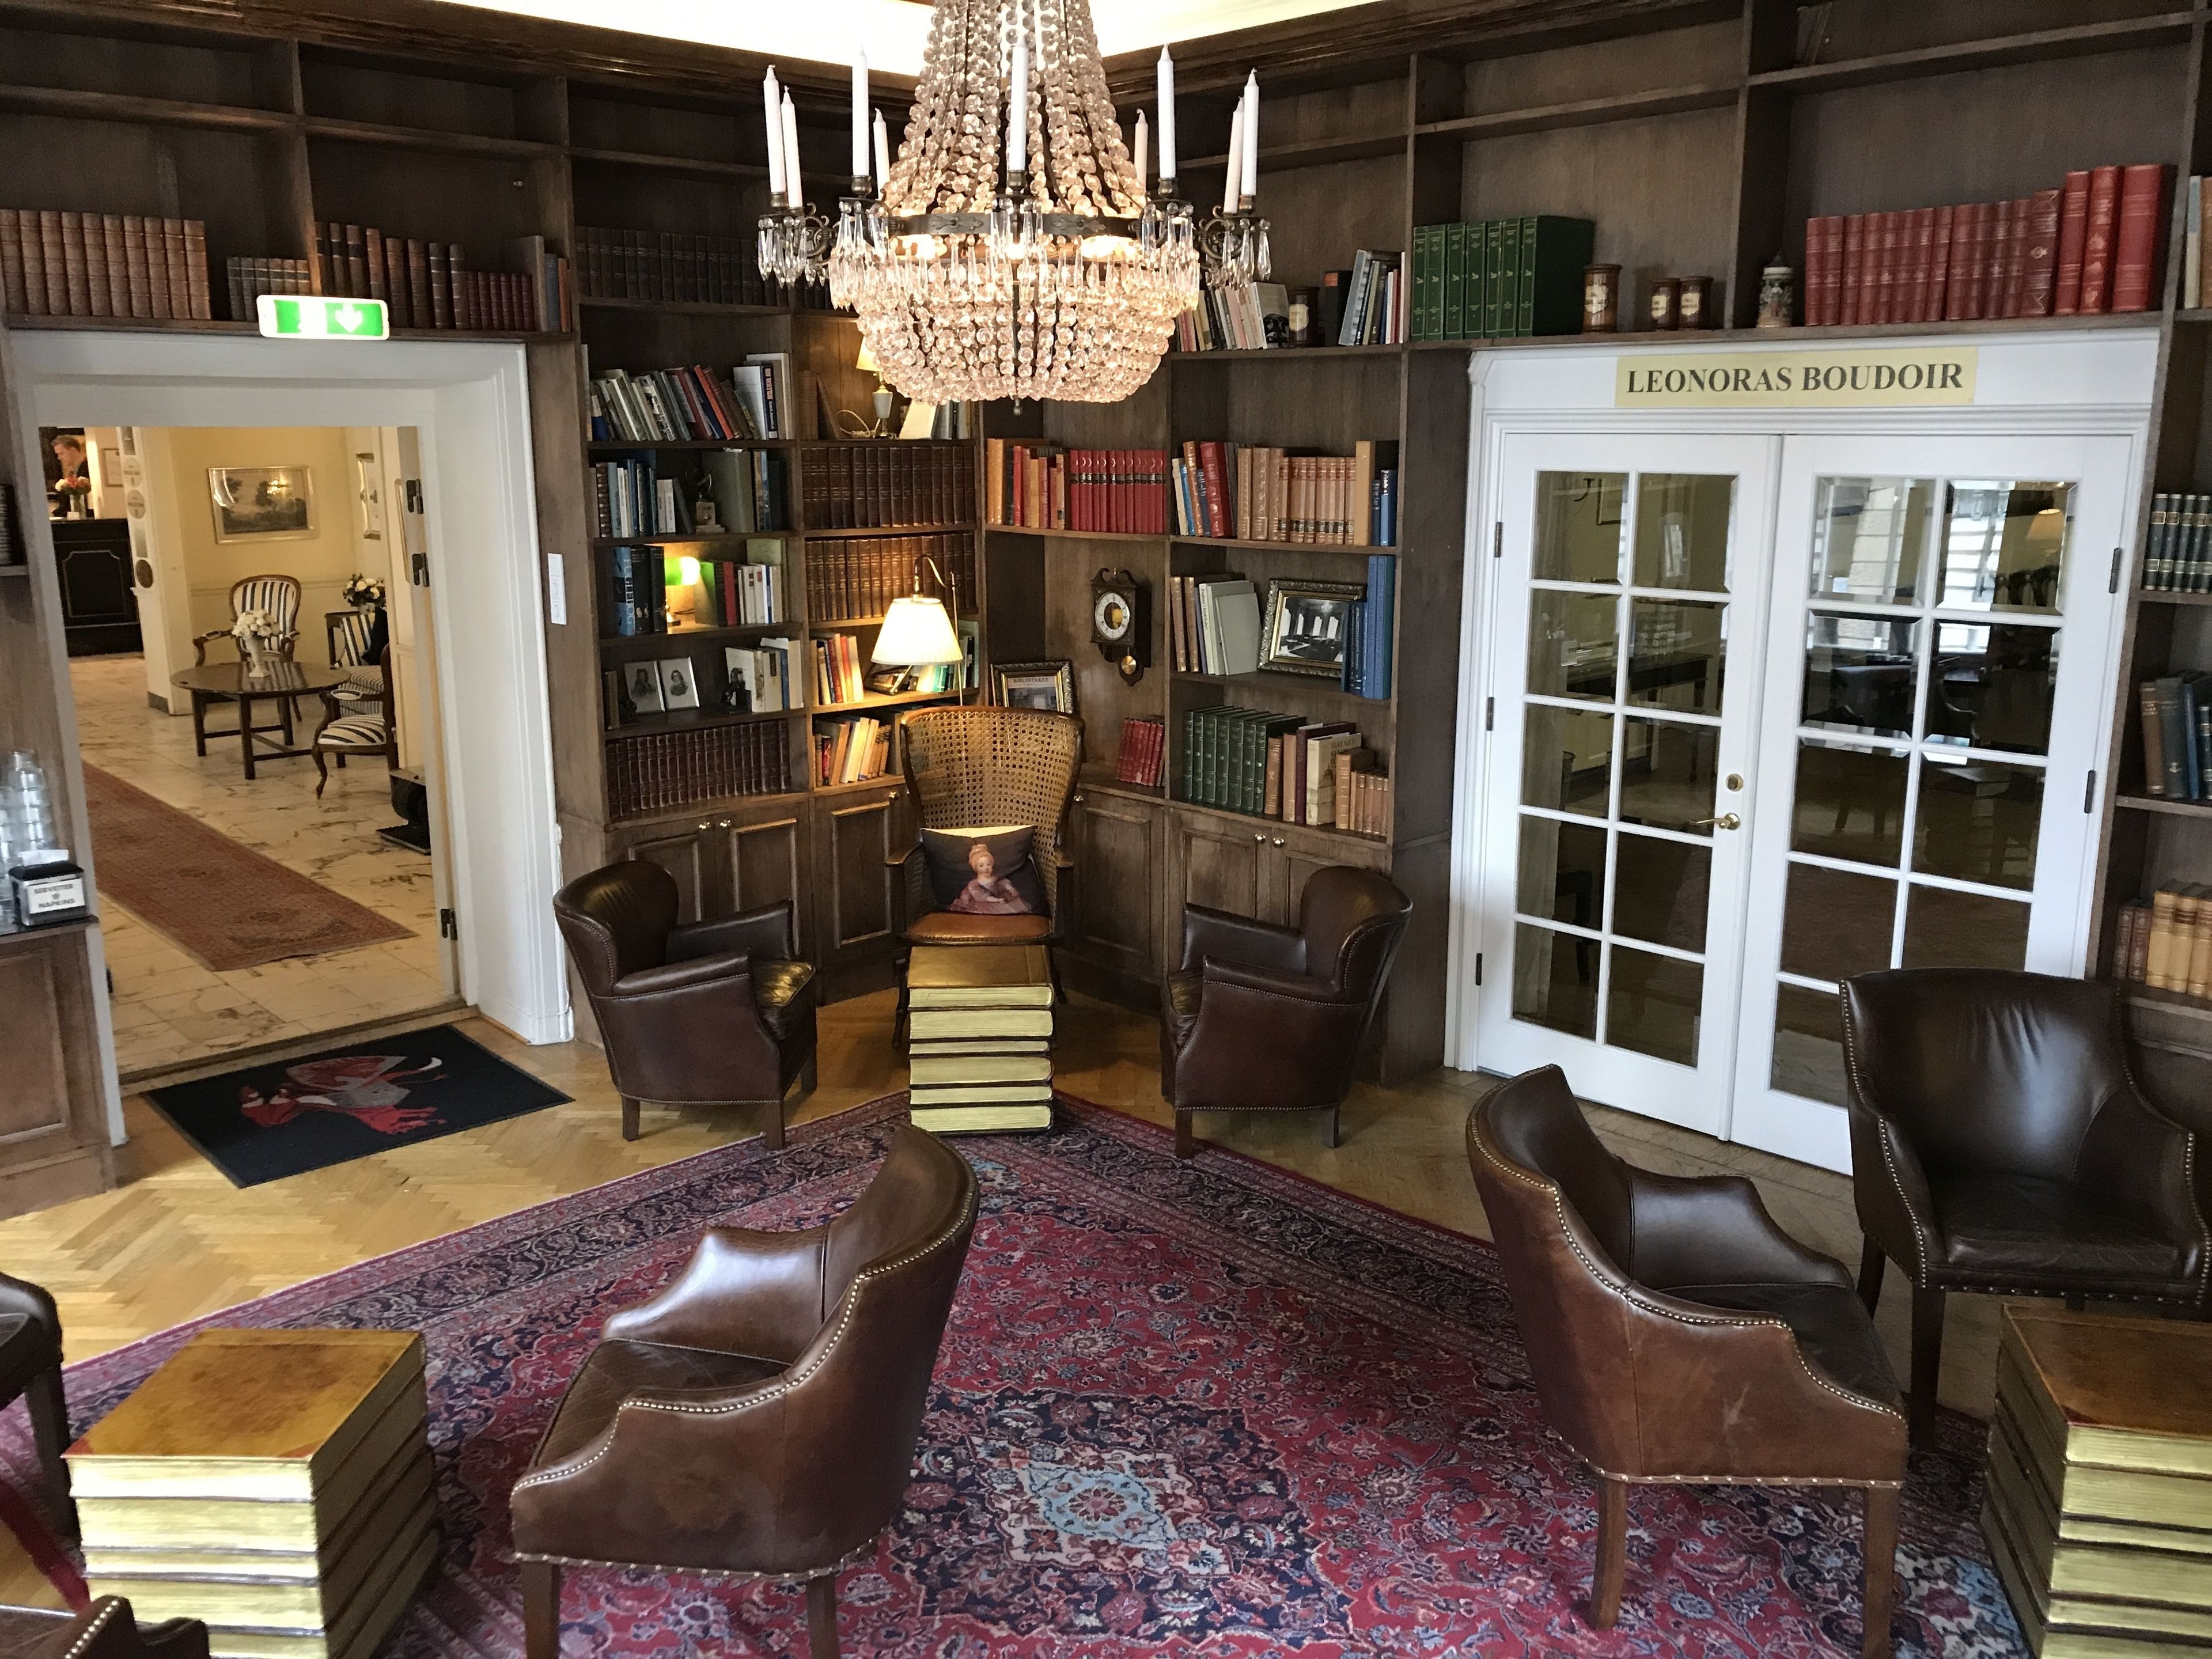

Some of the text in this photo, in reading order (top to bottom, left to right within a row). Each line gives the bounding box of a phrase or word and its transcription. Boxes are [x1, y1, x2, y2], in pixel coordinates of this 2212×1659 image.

[1626, 363, 1963, 393] LEONORAS BOUDOIR
[39, 899, 75, 908] NAPKINS
